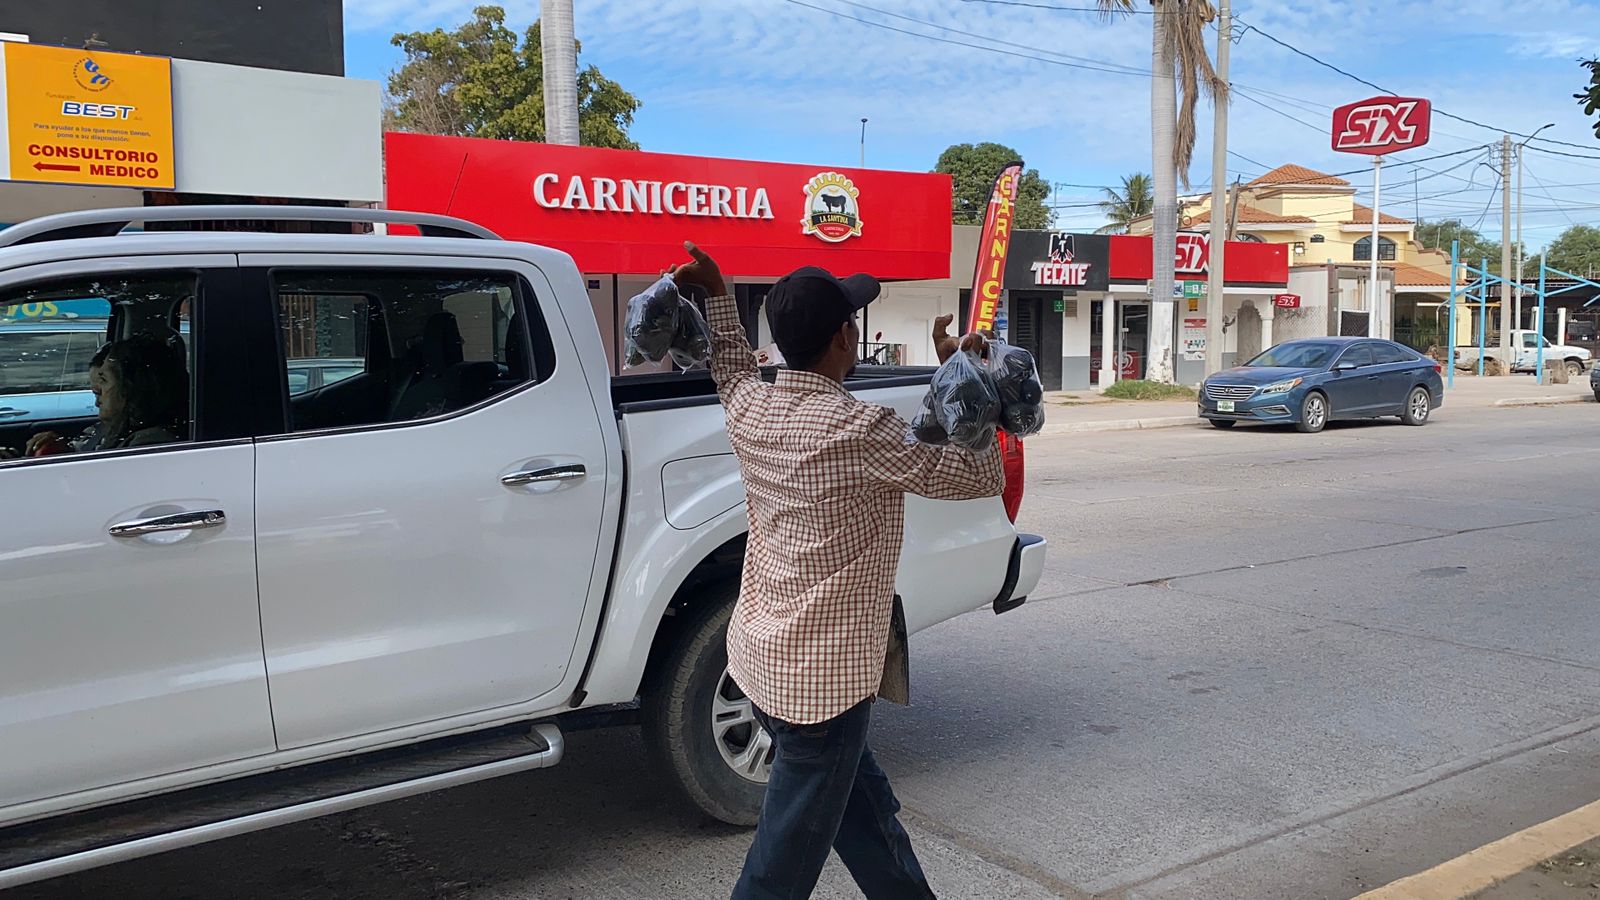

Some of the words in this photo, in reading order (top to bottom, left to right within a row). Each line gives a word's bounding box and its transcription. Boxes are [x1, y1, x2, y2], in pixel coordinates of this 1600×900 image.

[62, 101, 134, 119] BEST
[33, 122, 49, 130] Para
[28, 144, 158, 163] CONSULTORIO
[90, 164, 159, 179] MEDICO
[533, 172, 775, 221] CARNICERIA
[1030, 262, 1089, 285] TECATE
